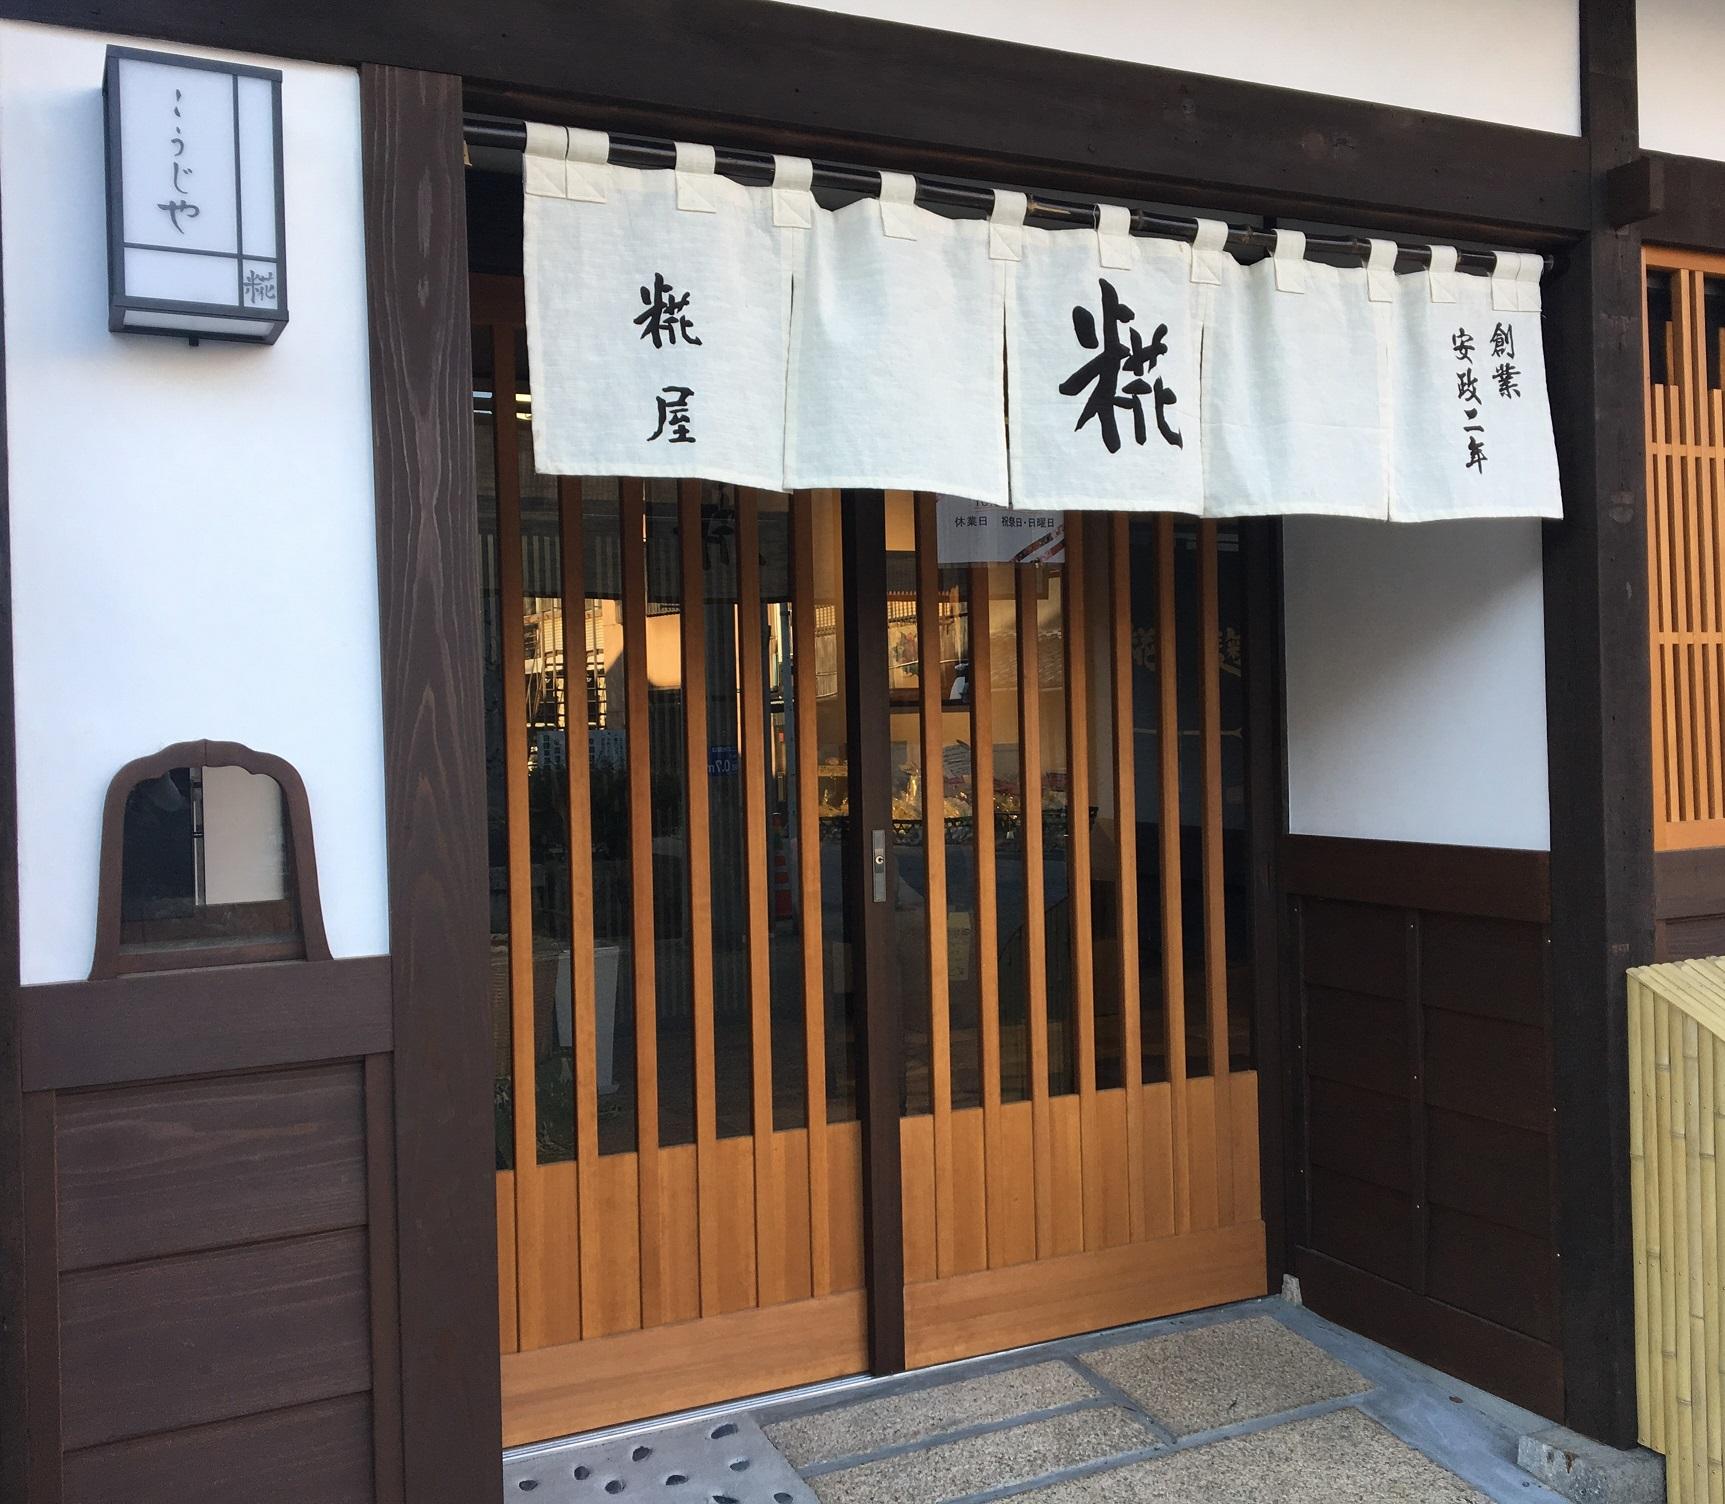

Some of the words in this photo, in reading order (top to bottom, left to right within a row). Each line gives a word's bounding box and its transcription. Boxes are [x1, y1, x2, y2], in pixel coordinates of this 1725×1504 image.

[157, 88, 201, 235] こうじや
[633, 272, 703, 443] 糀屋
[1058, 277, 1184, 454] 糀
[1452, 327, 1488, 475] 安政二年
[1489, 321, 1522, 400] 創業
[954, 515, 988, 528] 休業日
